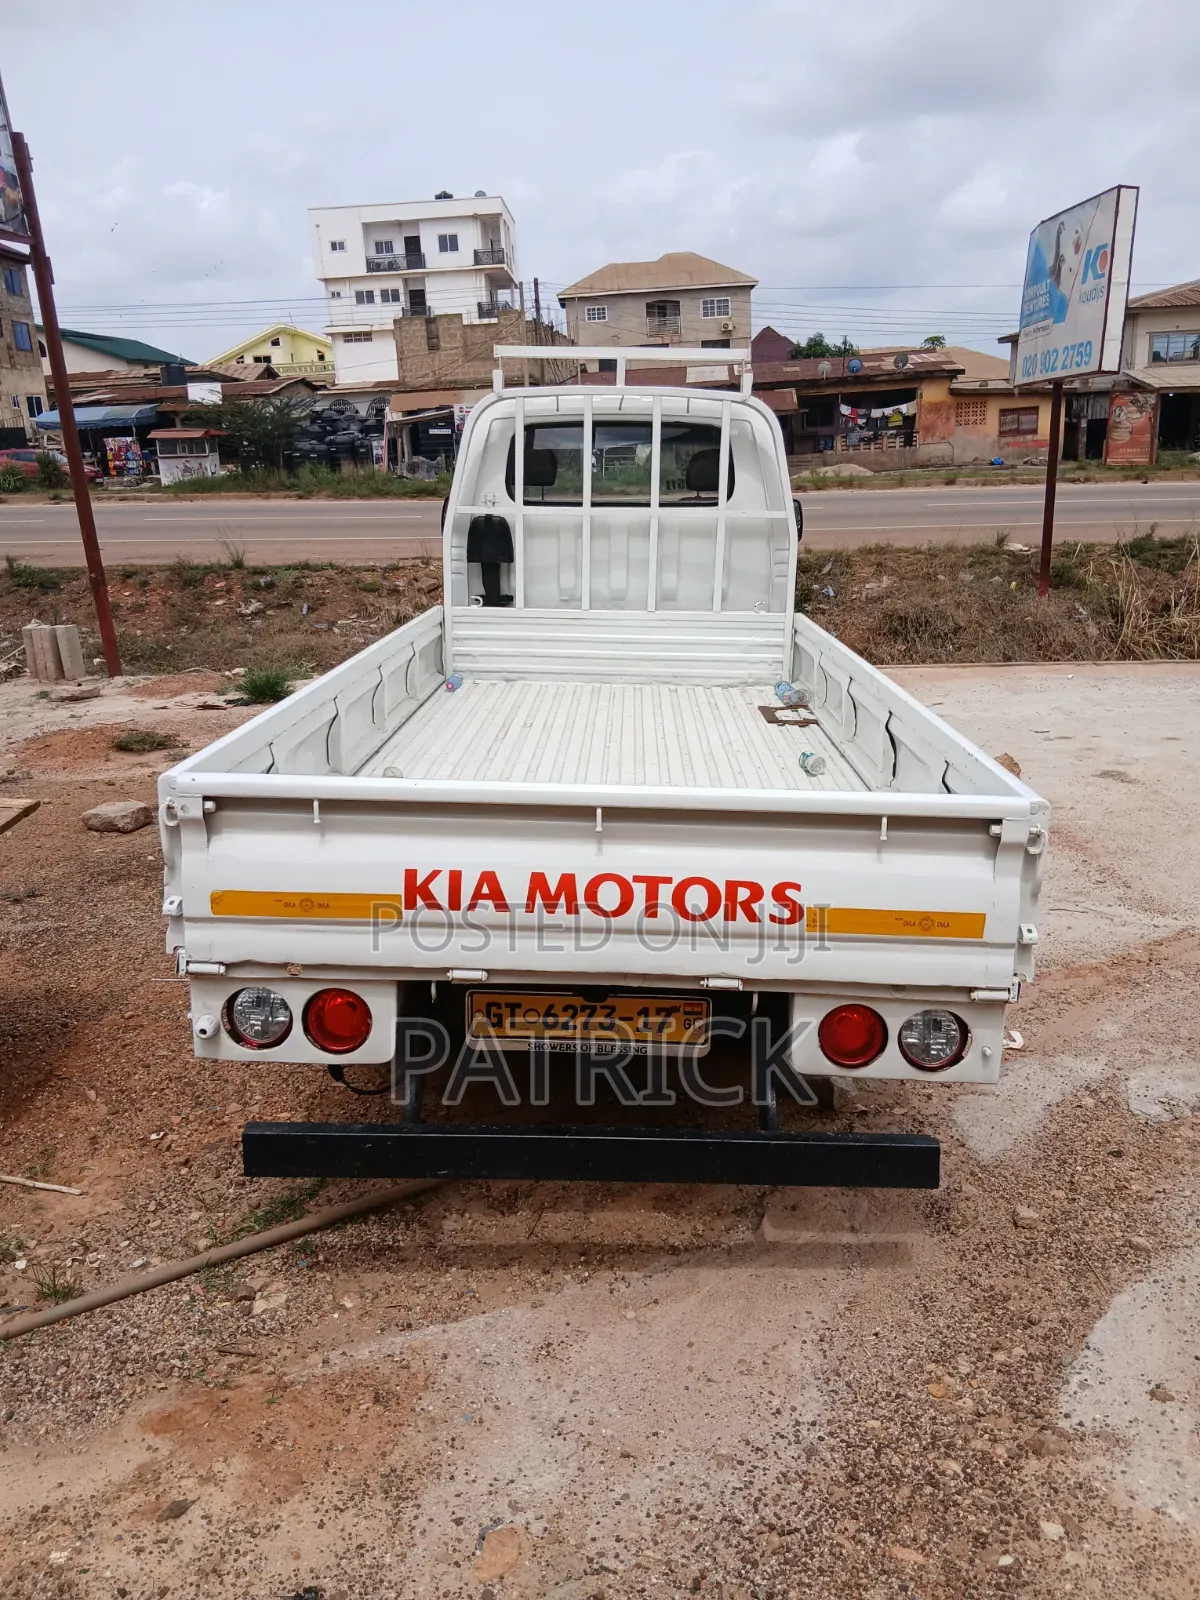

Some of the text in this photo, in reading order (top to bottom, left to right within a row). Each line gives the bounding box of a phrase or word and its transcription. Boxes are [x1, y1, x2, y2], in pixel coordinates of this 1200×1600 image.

[1022, 340, 1093, 378] 020 902 2759
[403, 868, 805, 925] KIA MOTORS
[485, 1001, 523, 1029] GT
[527, 1042, 648, 1055] SHOWERS OF BLESSING
